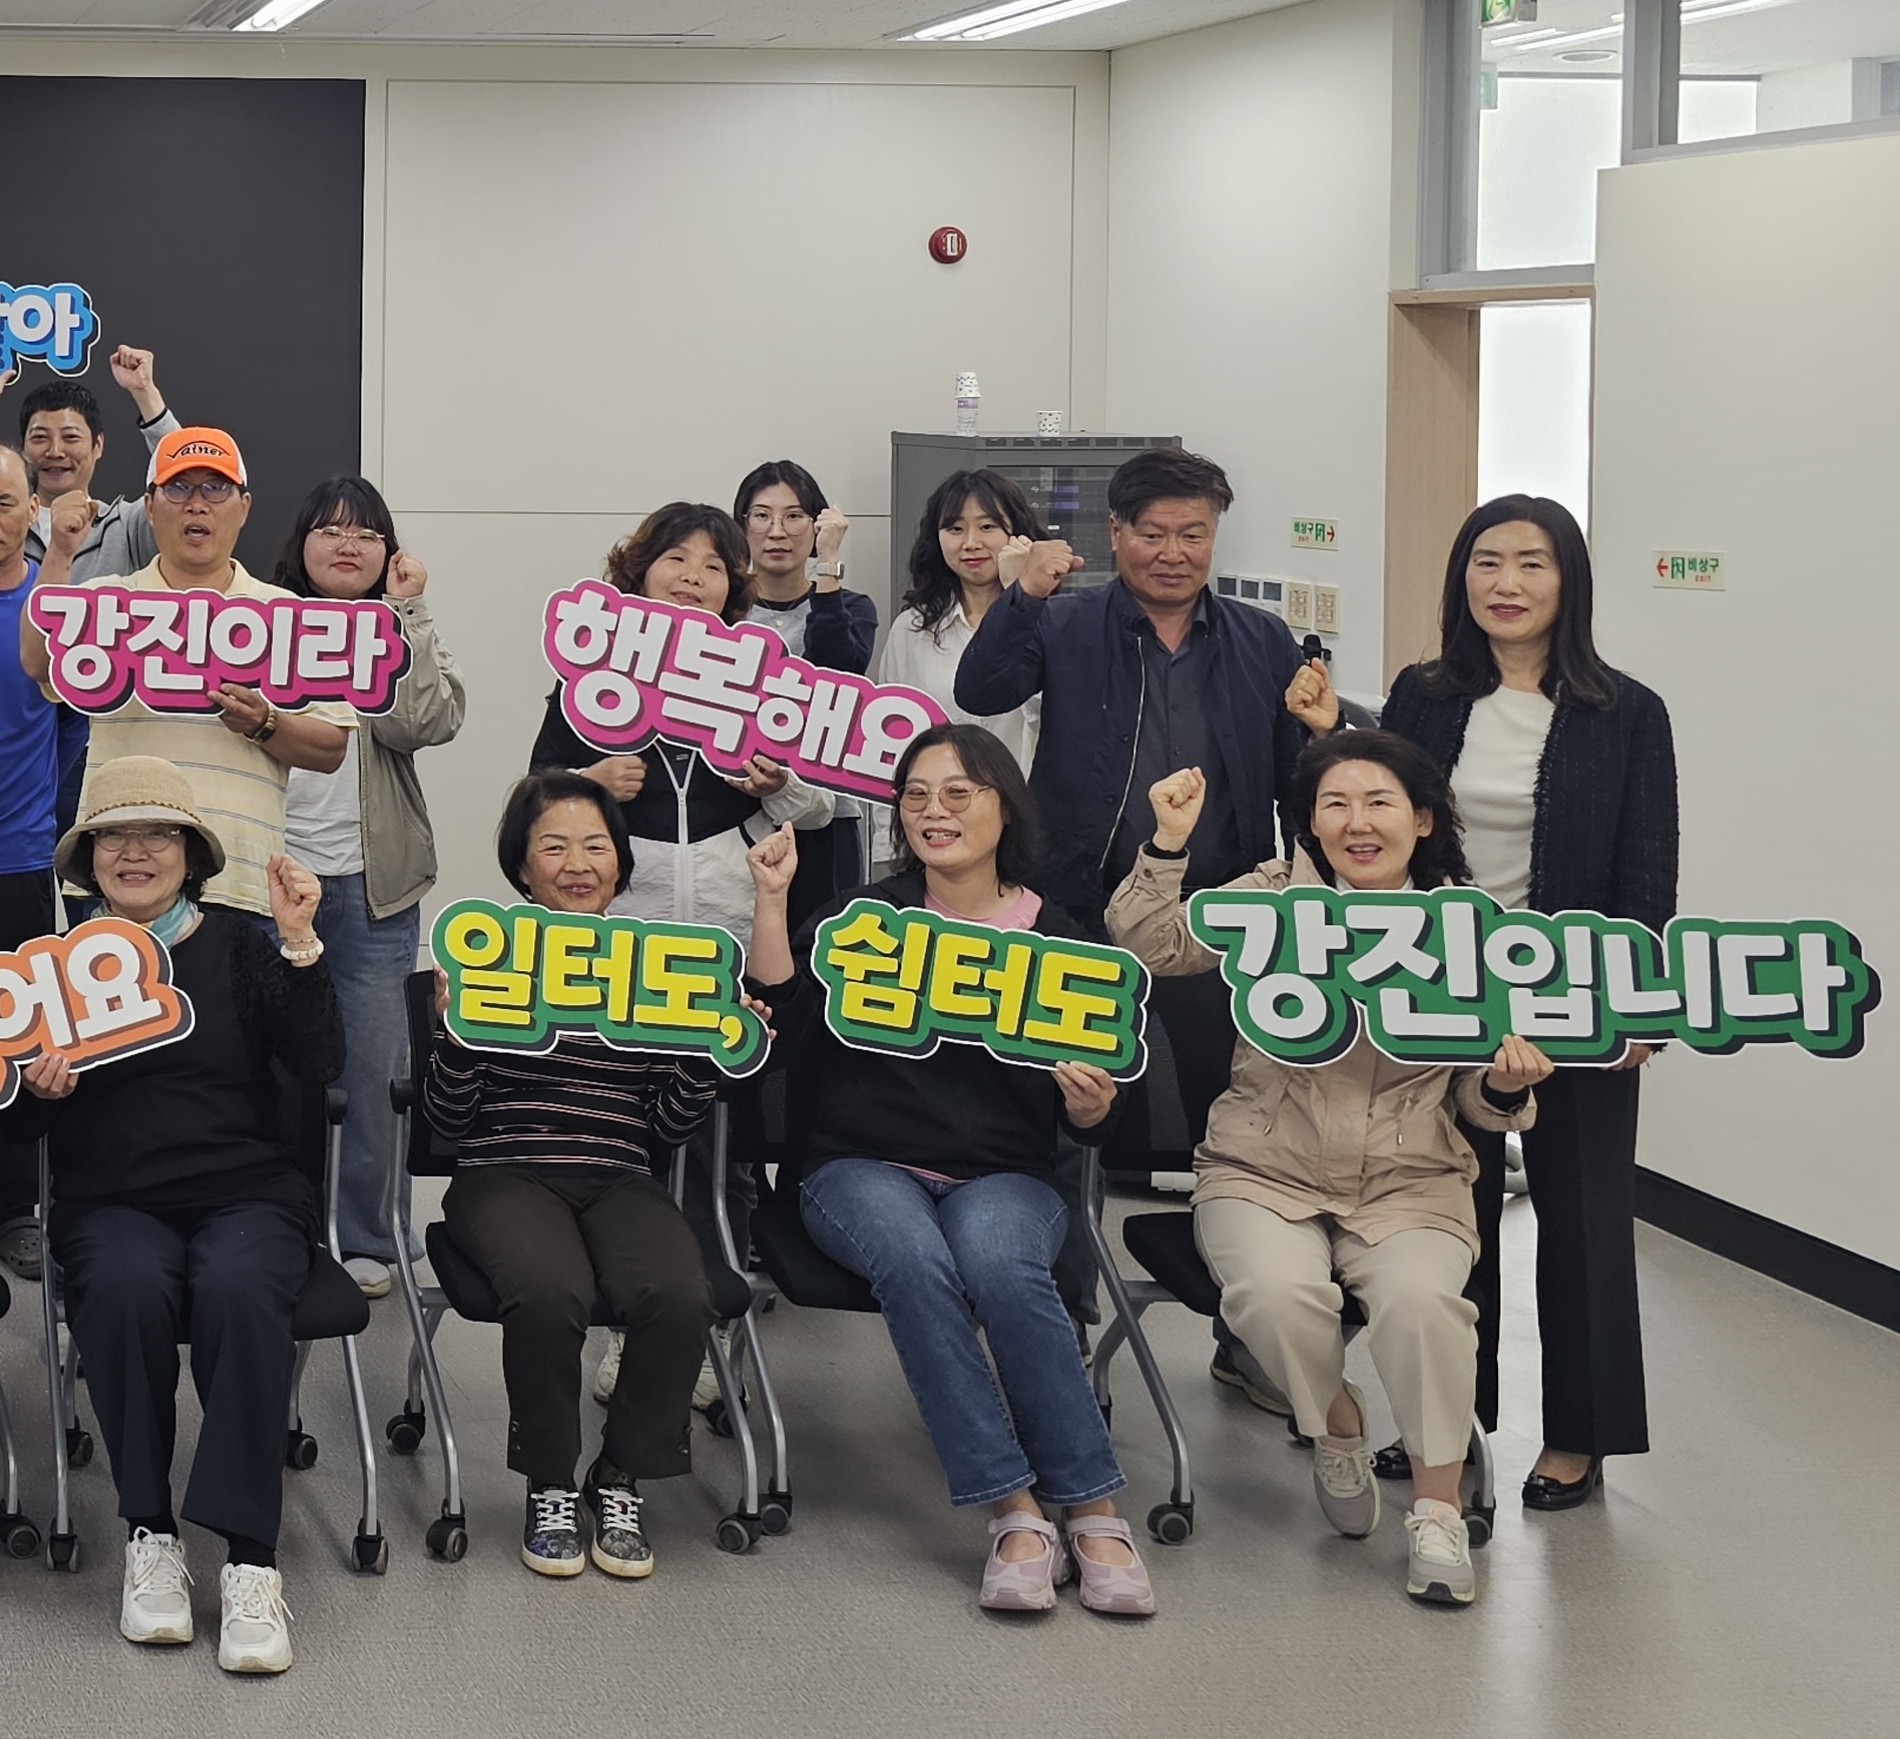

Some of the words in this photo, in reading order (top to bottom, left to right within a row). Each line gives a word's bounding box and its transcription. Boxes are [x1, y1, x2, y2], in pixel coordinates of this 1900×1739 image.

[1687, 557, 1719, 573] 비상구
[39, 594, 387, 691] 강진이라
[555, 588, 932, 781] 행복해요
[444, 911, 743, 1051] 일터도,
[826, 912, 1120, 1051] 쉼터도
[1202, 900, 1847, 1040] 강진입니다
